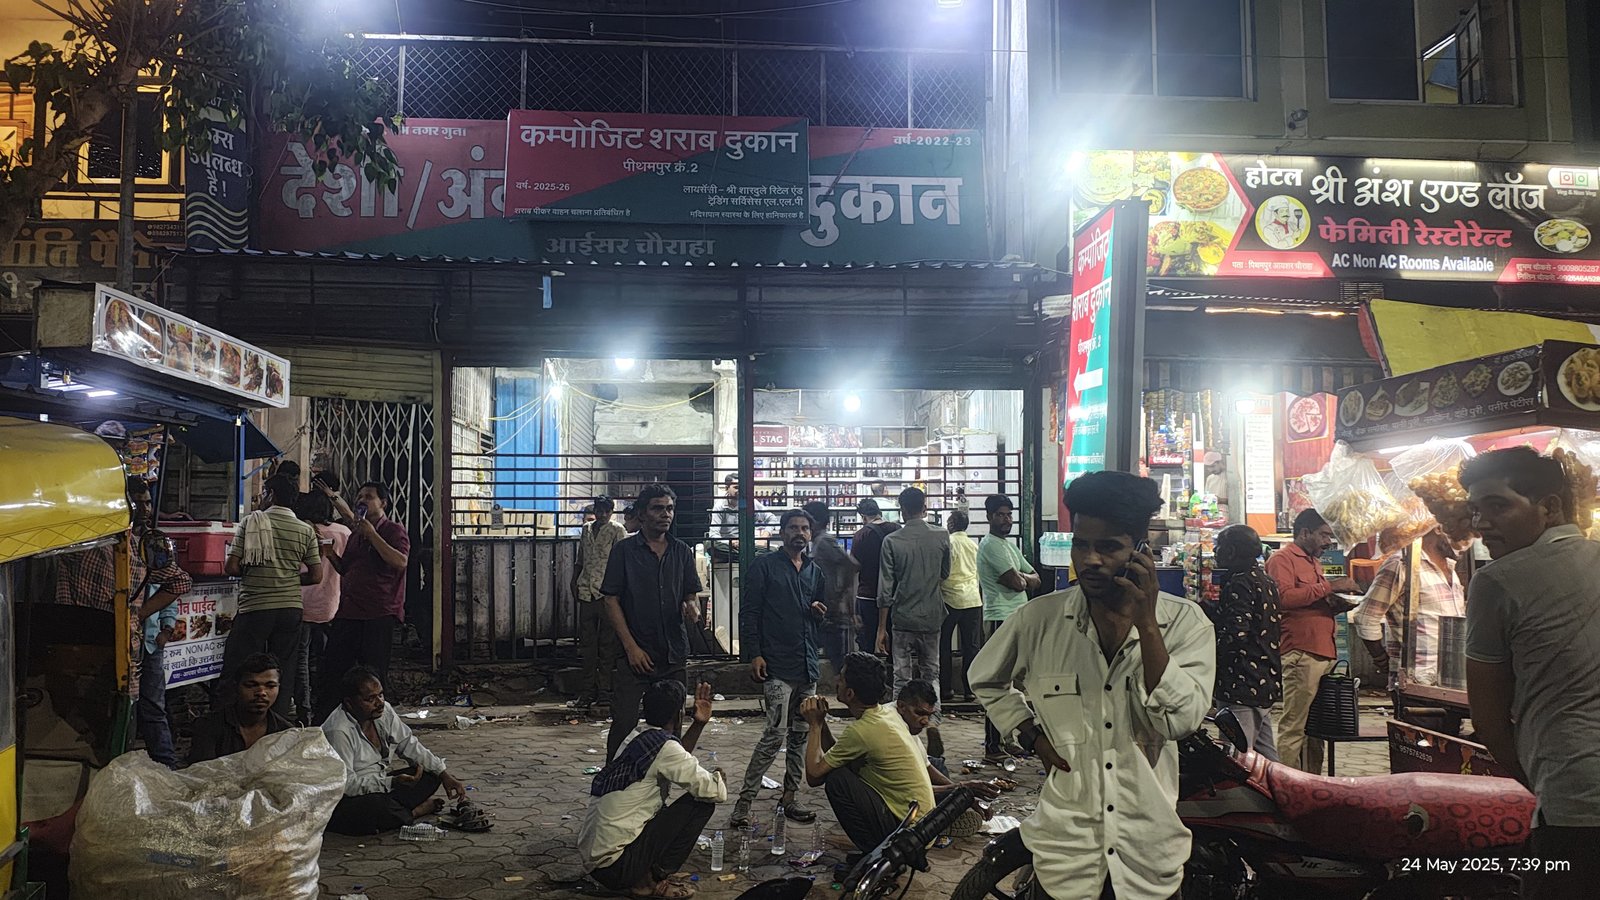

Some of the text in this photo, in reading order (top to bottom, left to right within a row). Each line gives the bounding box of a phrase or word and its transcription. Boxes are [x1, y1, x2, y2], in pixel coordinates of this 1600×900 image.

[412, 126, 439, 136] नगर
[520, 119, 799, 159] कम्पोजिट शराब दुकान
[623, 159, 671, 175] पीथमपुर
[1246, 164, 1303, 189] होटल
[533, 182, 570, 192] 2025-26
[726, 184, 737, 195] श्री
[769, 186, 788, 196] रिटेल
[790, 186, 804, 196] एंड
[1310, 166, 1548, 213] श्री अंश एण्ड लॉज
[708, 195, 728, 207] ट्रेडिंग
[514, 207, 532, 215] शराब
[743, 210, 750, 219] के
[751, 210, 764, 219] लिए
[800, 176, 963, 247] दुकान
[1318, 216, 1513, 250] फेमिली रेस्टोरेन्ट
[546, 231, 715, 258] आईसर चौराहा
[1078, 229, 1111, 276] कम्पोजिट
[1332, 255, 1494, 271] AC Non AC Rooms Available
[1072, 277, 1112, 323] शराब दुकान
[186, 645, 203, 655] NON
[204, 642, 215, 652] AC
